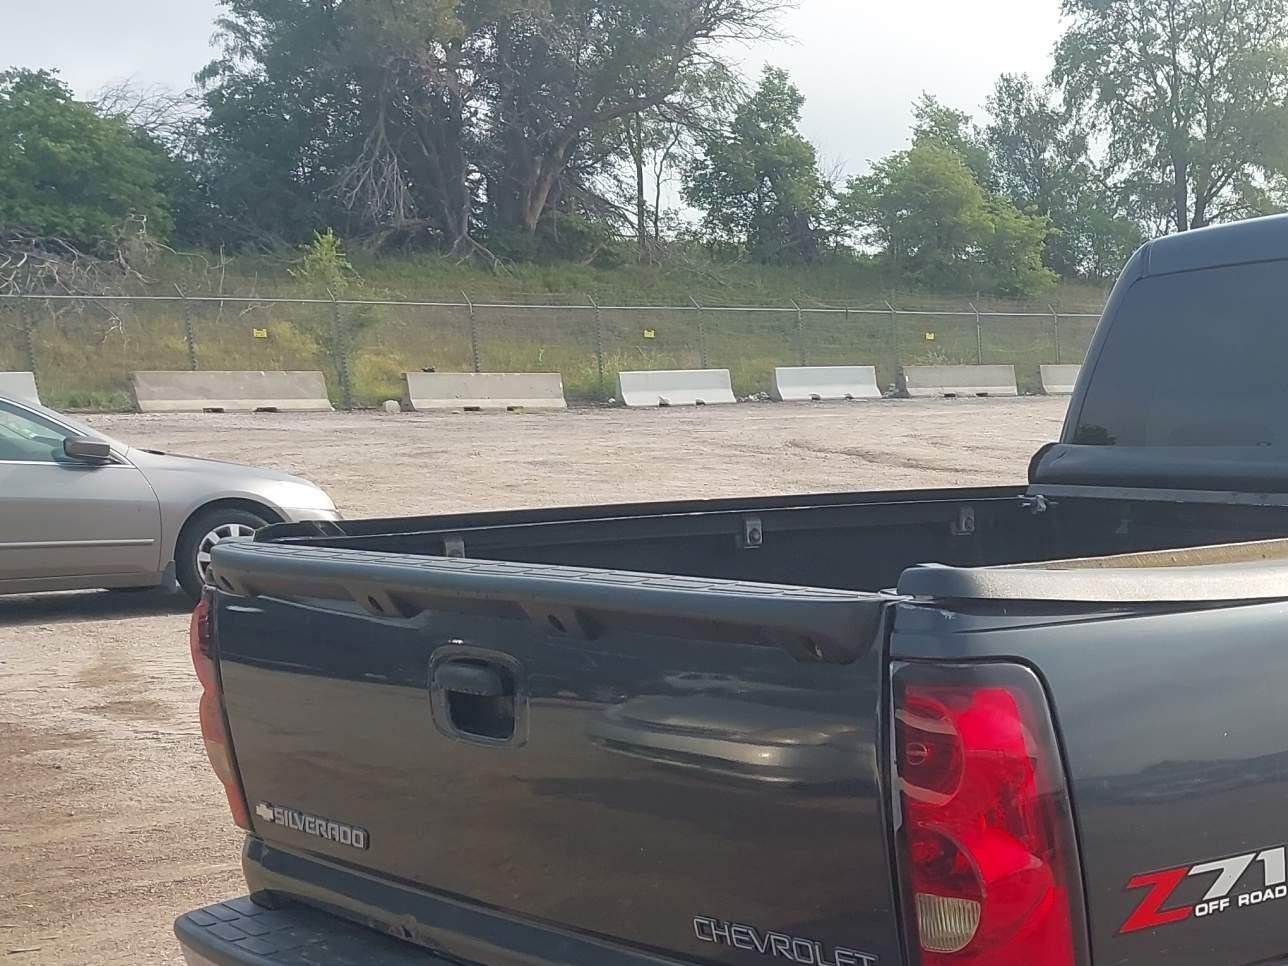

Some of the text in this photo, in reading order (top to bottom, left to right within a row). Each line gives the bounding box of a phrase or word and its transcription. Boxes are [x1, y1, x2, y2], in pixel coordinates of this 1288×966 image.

[273, 806, 364, 849] SILVERADO
[1118, 845, 1287, 934] Z71
[1194, 884, 1288, 917] OFF ROAD
